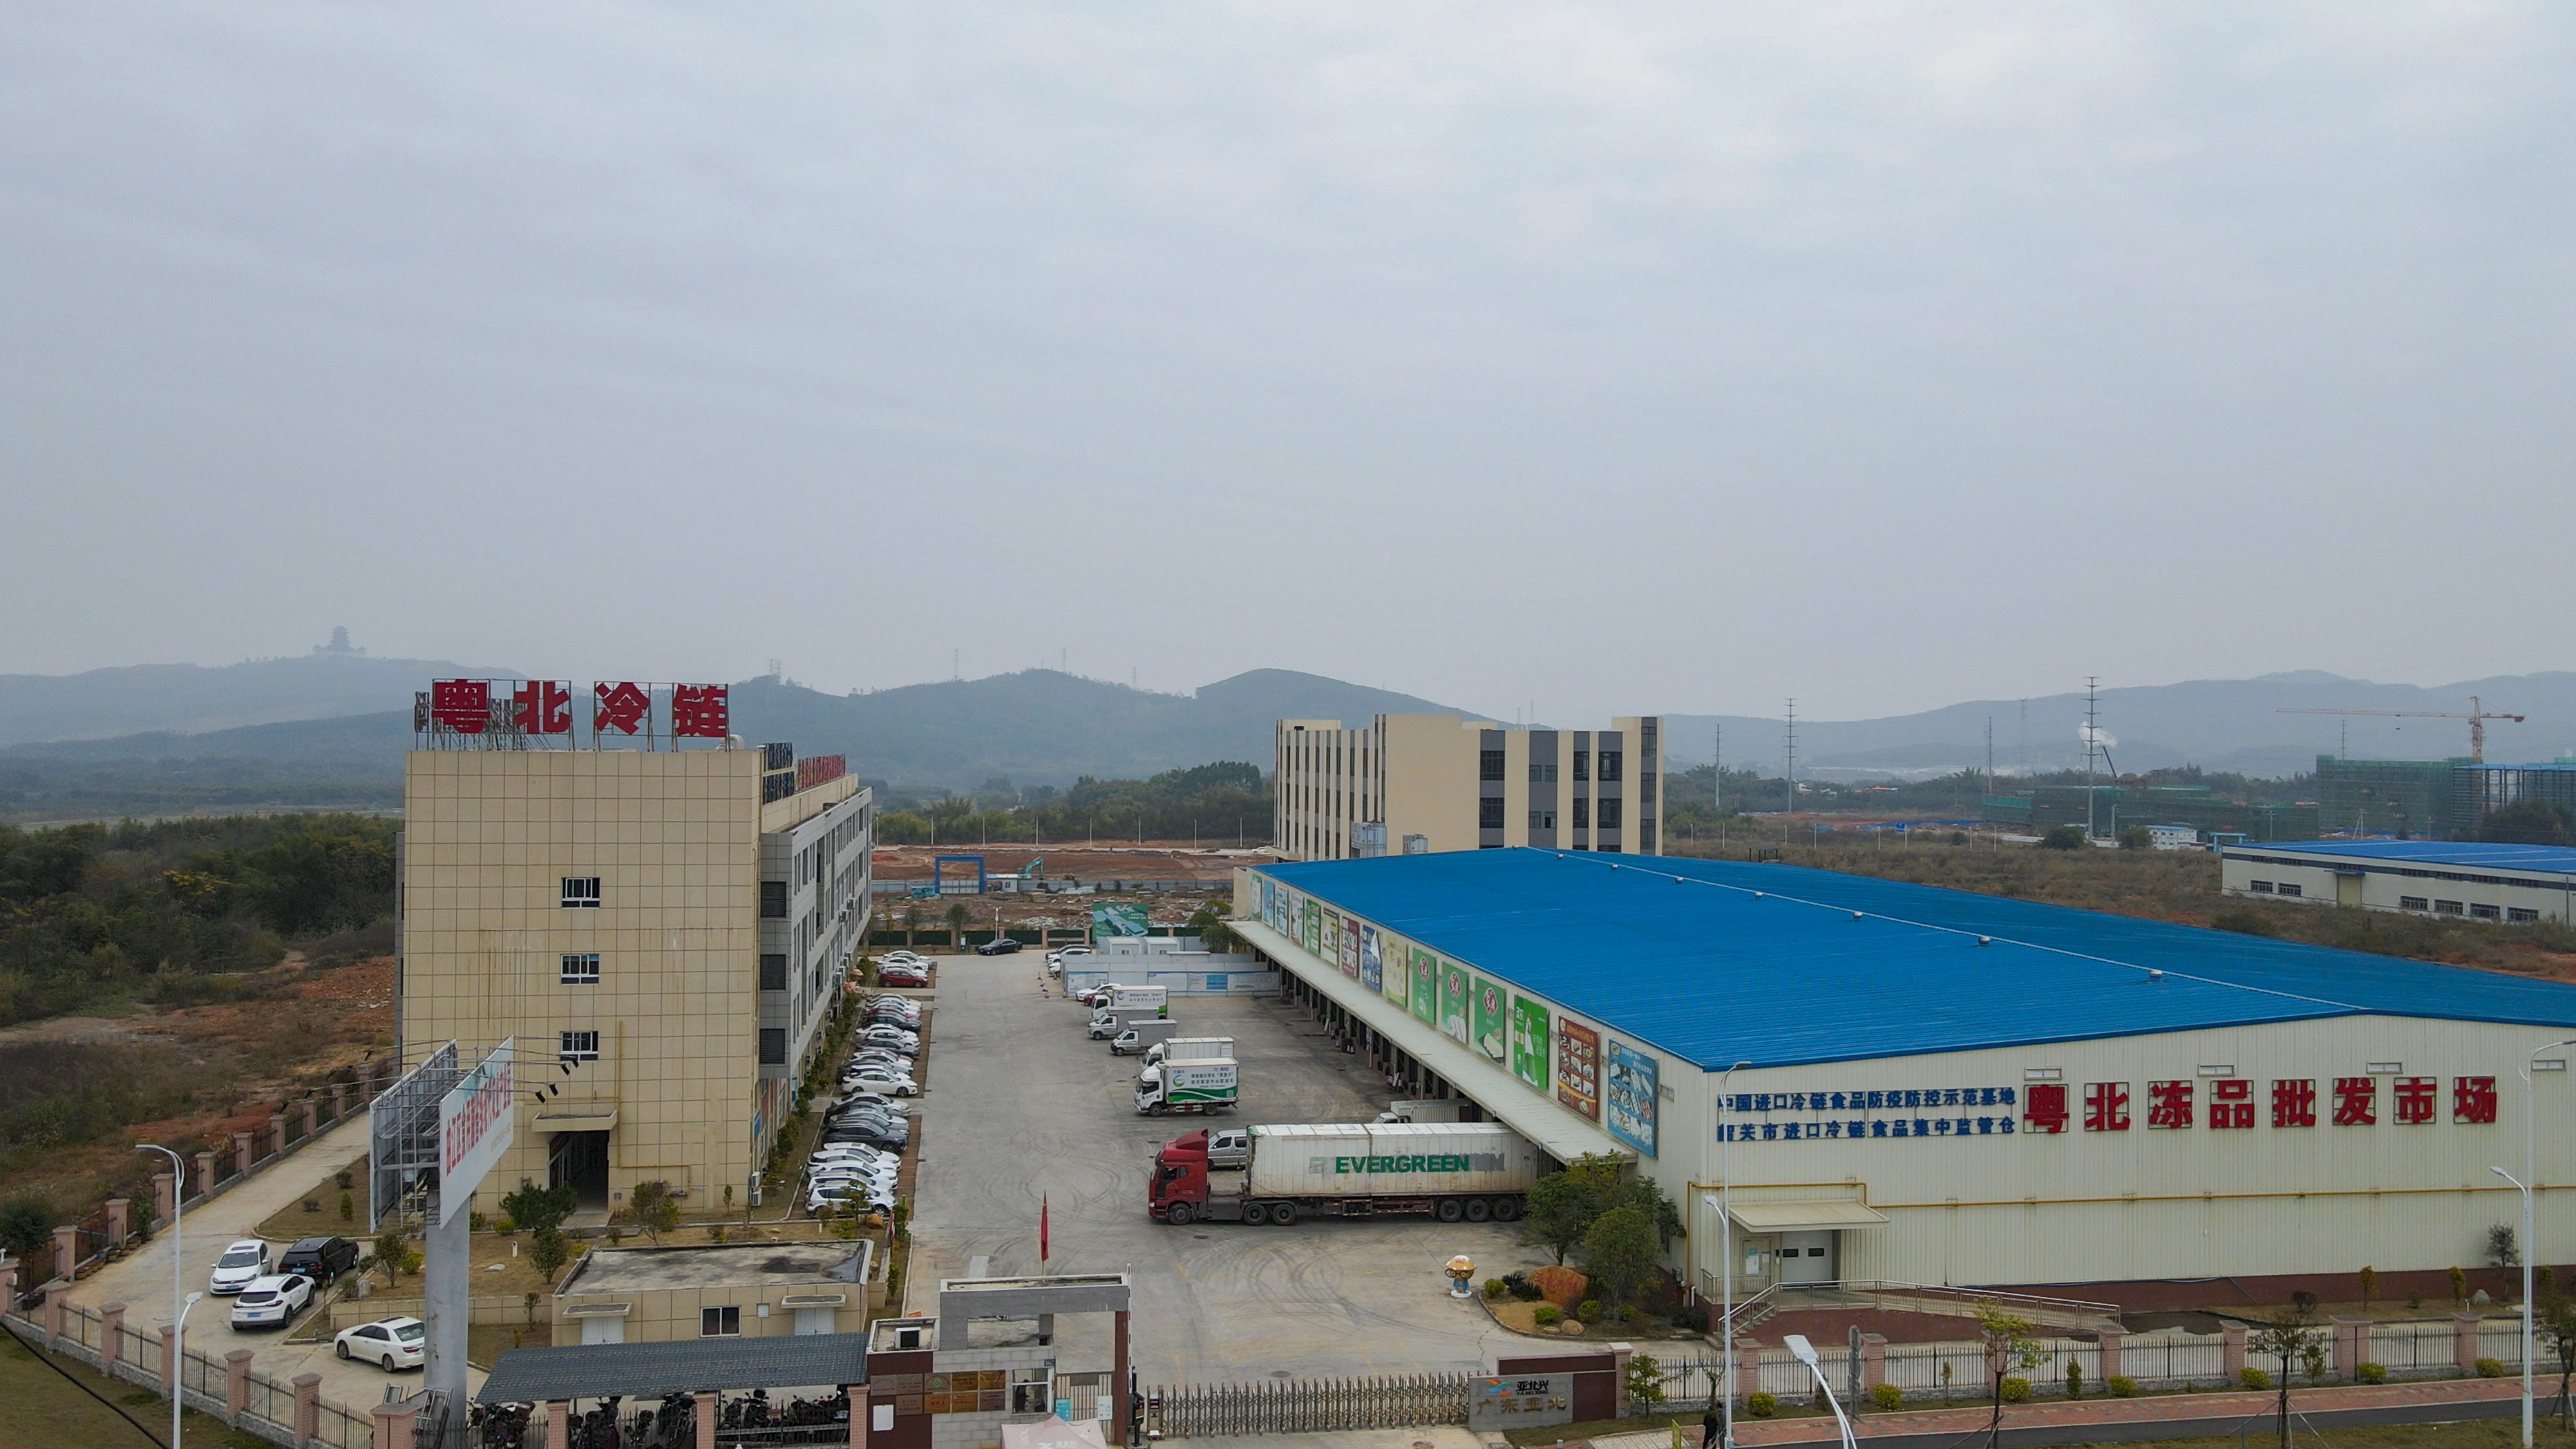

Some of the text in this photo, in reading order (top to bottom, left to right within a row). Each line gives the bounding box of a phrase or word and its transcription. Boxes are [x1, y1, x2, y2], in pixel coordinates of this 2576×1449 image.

[432, 679, 727, 736] 粤北冷链
[2024, 1077, 2497, 1133] 粤北冻品批发市场
[1335, 1155, 1469, 1173] EVERGREEN
[1516, 1380, 1549, 1391] 亚北兴
[1477, 1395, 1566, 1415] 广东亚北
